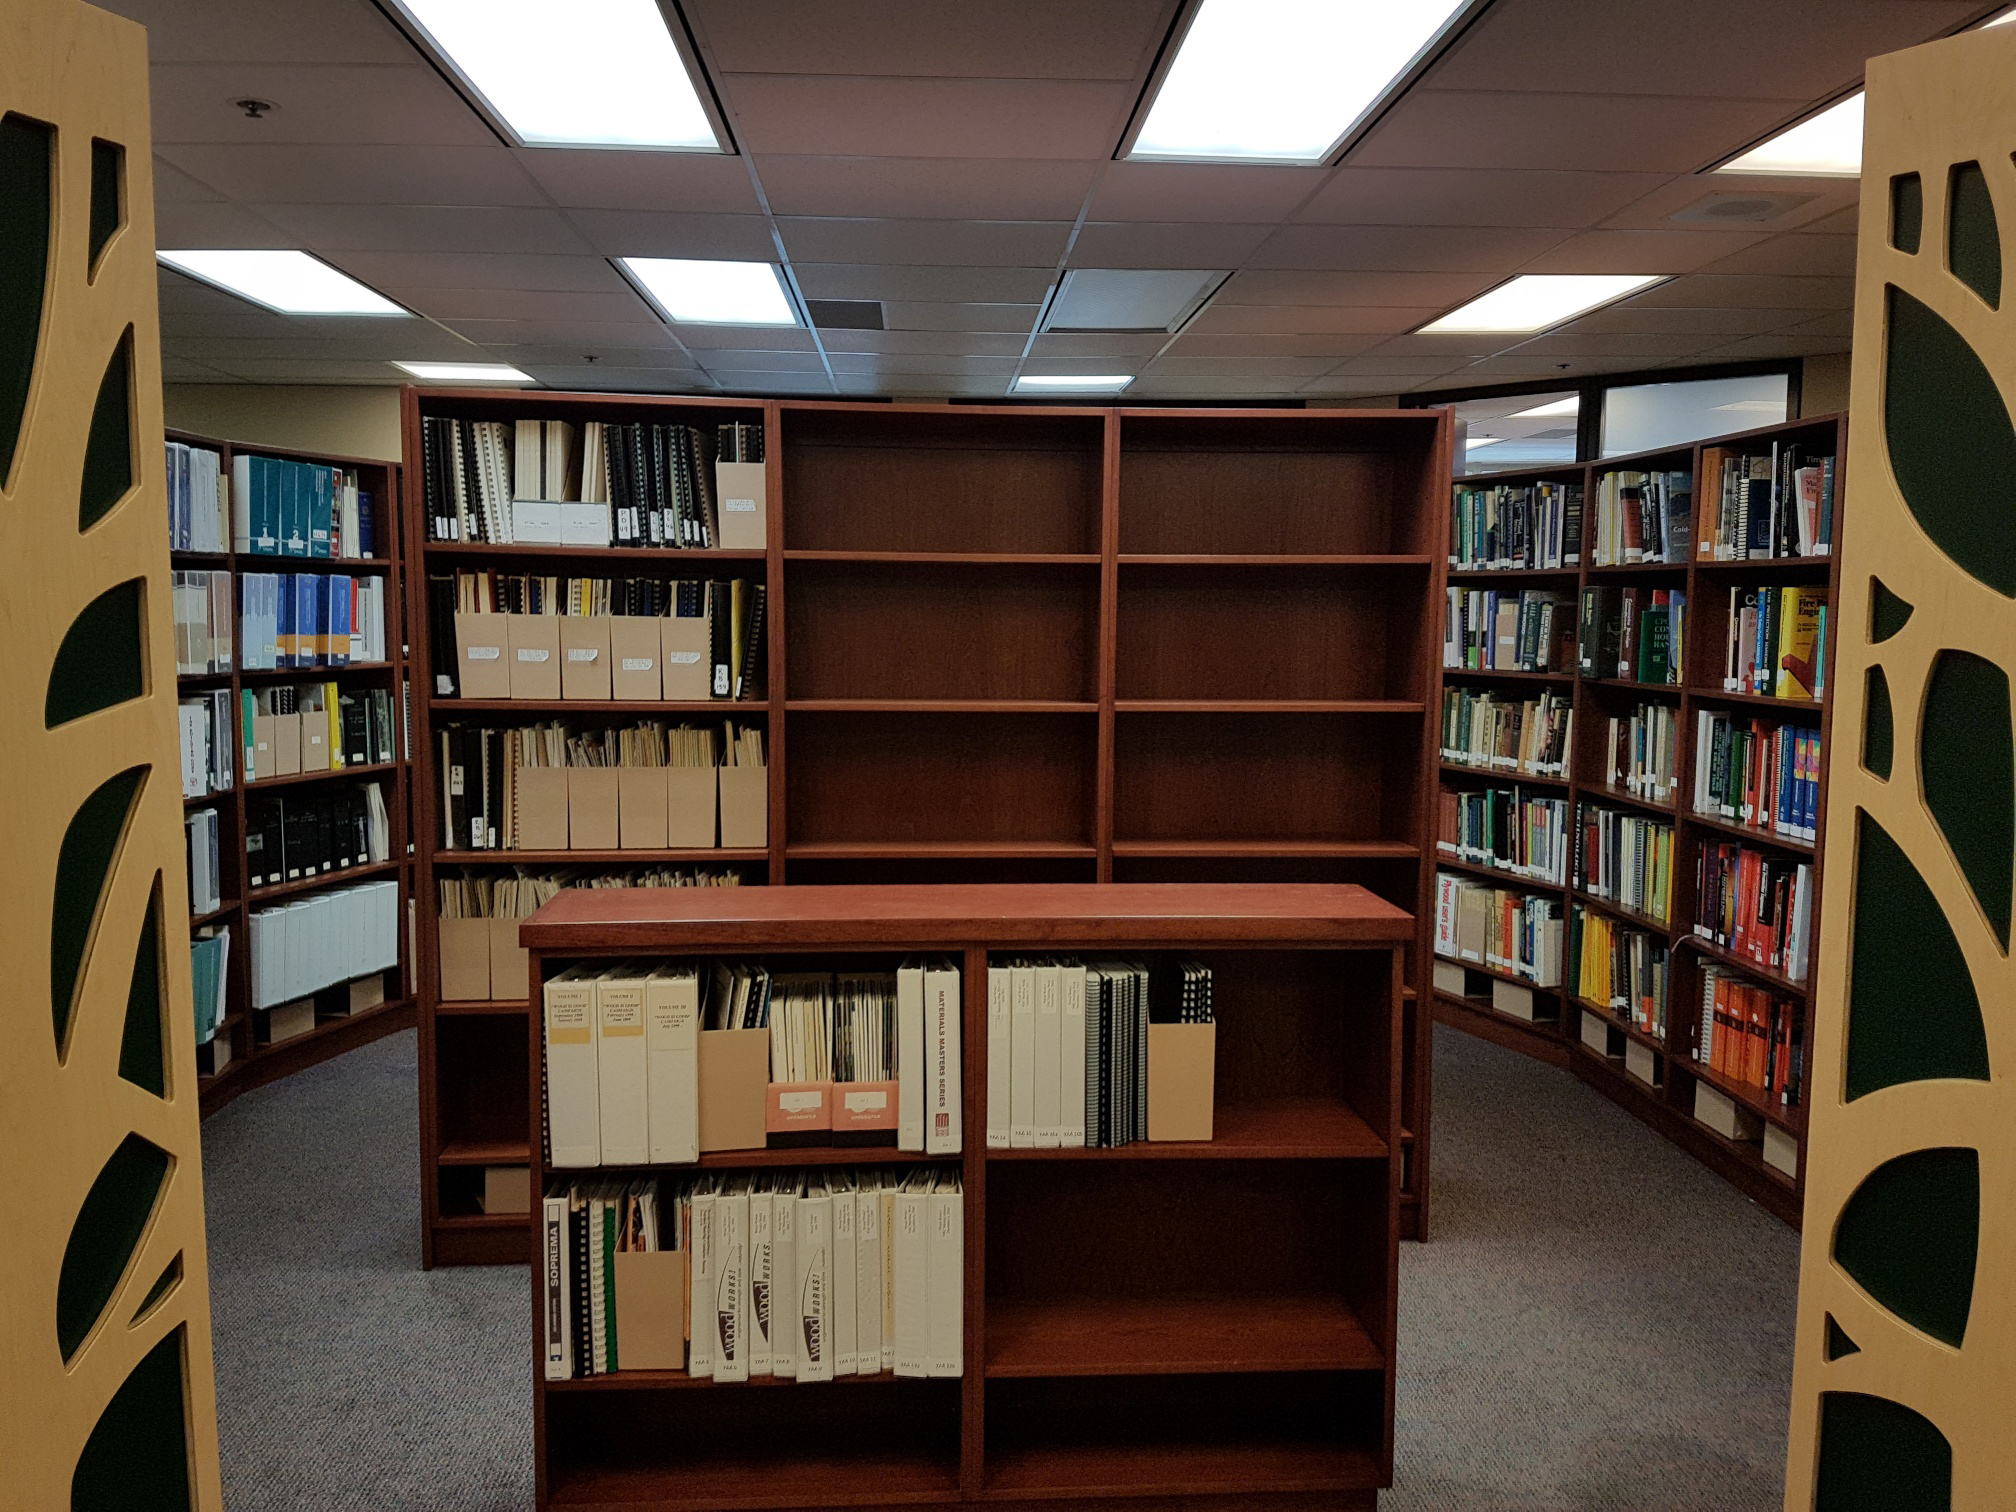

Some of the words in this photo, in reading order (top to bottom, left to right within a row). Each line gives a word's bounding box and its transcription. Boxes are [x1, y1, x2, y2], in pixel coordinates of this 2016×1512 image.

[1799, 599, 1816, 607] Fire
[1442, 880, 1452, 904] Plywood
[1442, 906, 1450, 922] user's
[1440, 924, 1449, 941] guide
[755, 1284, 769, 1323] wood
[720, 1314, 735, 1353] wood
[805, 1318, 820, 1358] wood
